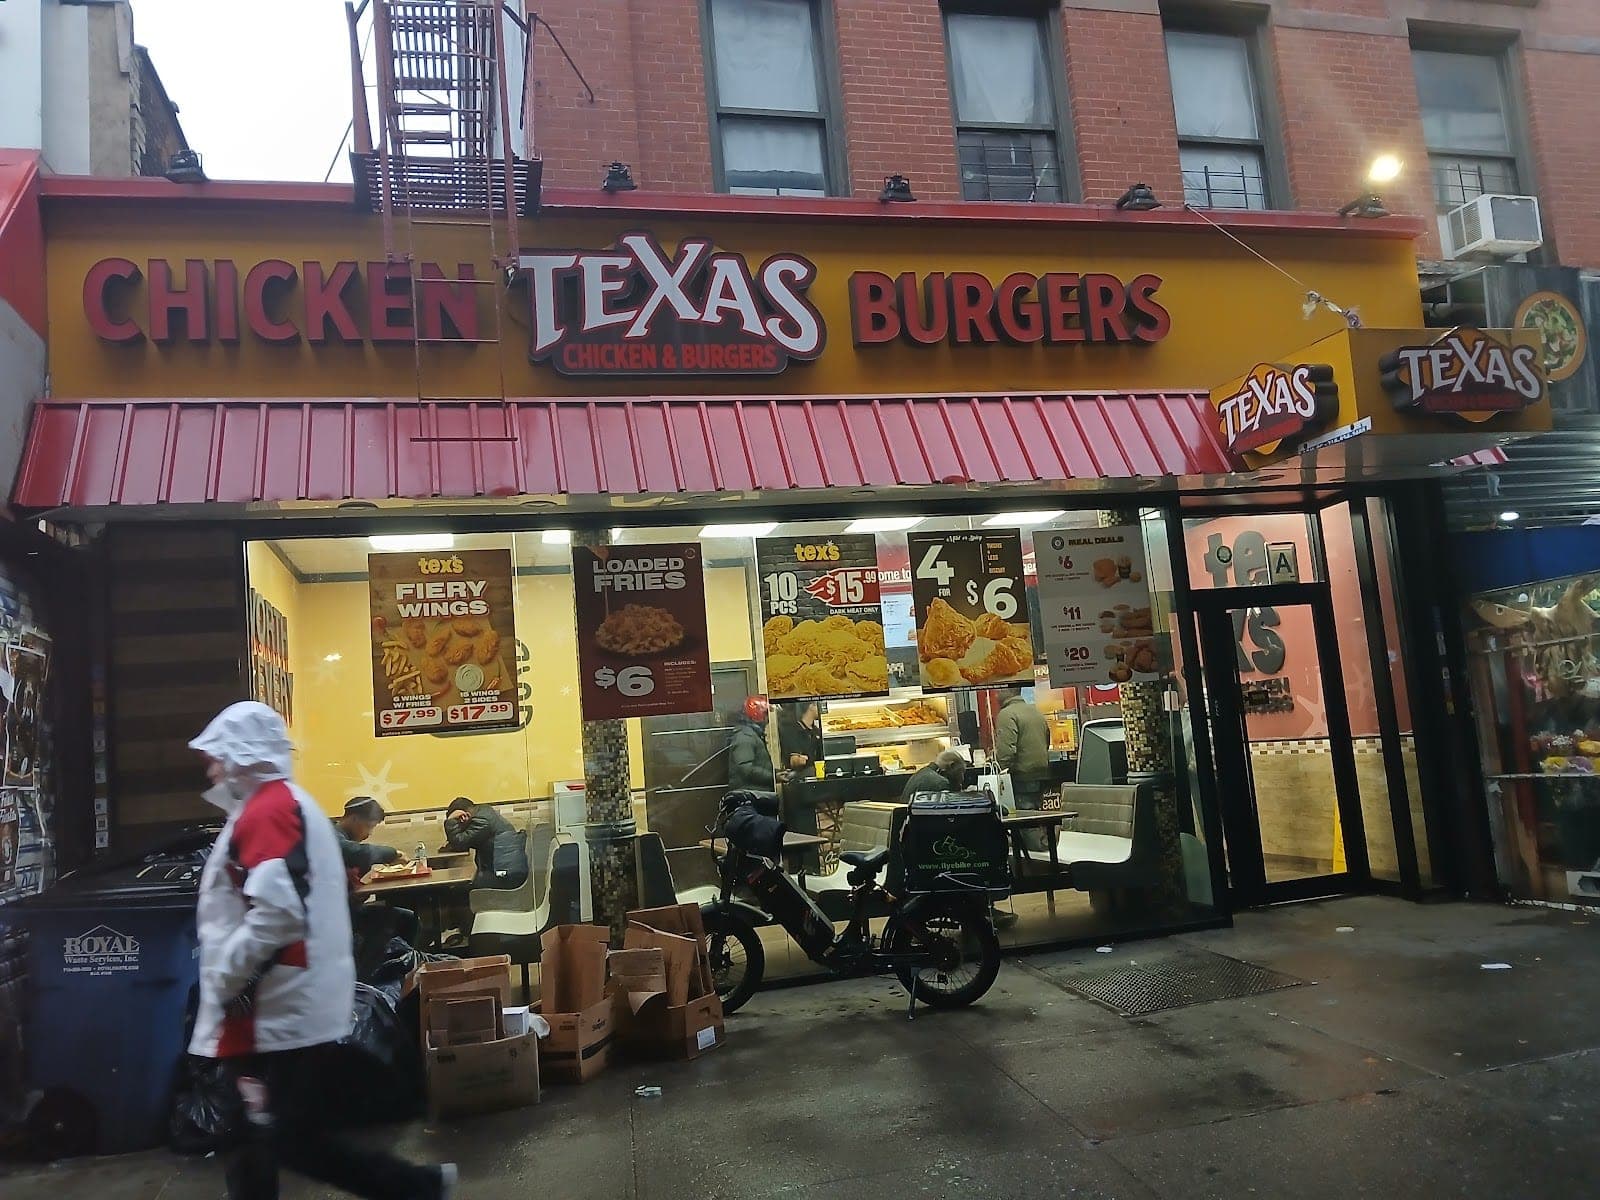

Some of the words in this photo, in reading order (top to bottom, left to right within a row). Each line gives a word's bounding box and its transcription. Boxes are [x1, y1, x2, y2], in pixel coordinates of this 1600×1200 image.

[83, 257, 480, 342] CHICKEN
[518, 234, 819, 352] TEXAS
[850, 271, 1171, 344] BURGERS
[563, 344, 657, 369] CHICKEN
[662, 344, 677, 368] &
[682, 344, 777, 369] BURGERS
[1399, 337, 1540, 400] TEXAS
[1218, 367, 1316, 446] TEXAS
[1068, 537, 1093, 546] MEAL
[1094, 535, 1124, 544] DEALS
[592, 557, 685, 573] LOADED
[916, 544, 955, 585] 4
[1058, 556, 1073, 570] $6
[1276, 552, 1293, 574] A
[396, 580, 487, 601] FIERY
[593, 572, 686, 592] FRIES
[764, 571, 799, 602] 10
[826, 571, 877, 604] $15.99
[938, 588, 951, 597] FOR
[966, 577, 1018, 620] $6
[397, 600, 489, 618] WINGS
[770, 600, 798, 615] PCS
[1063, 606, 1081, 620] $11
[1064, 647, 1090, 661] $20
[594, 665, 655, 697] $6
[401, 694, 432, 702] WINGS
[471, 690, 501, 698] WINGS
[472, 696, 498, 704] SIDES
[64, 936, 140, 955] ROYAL
